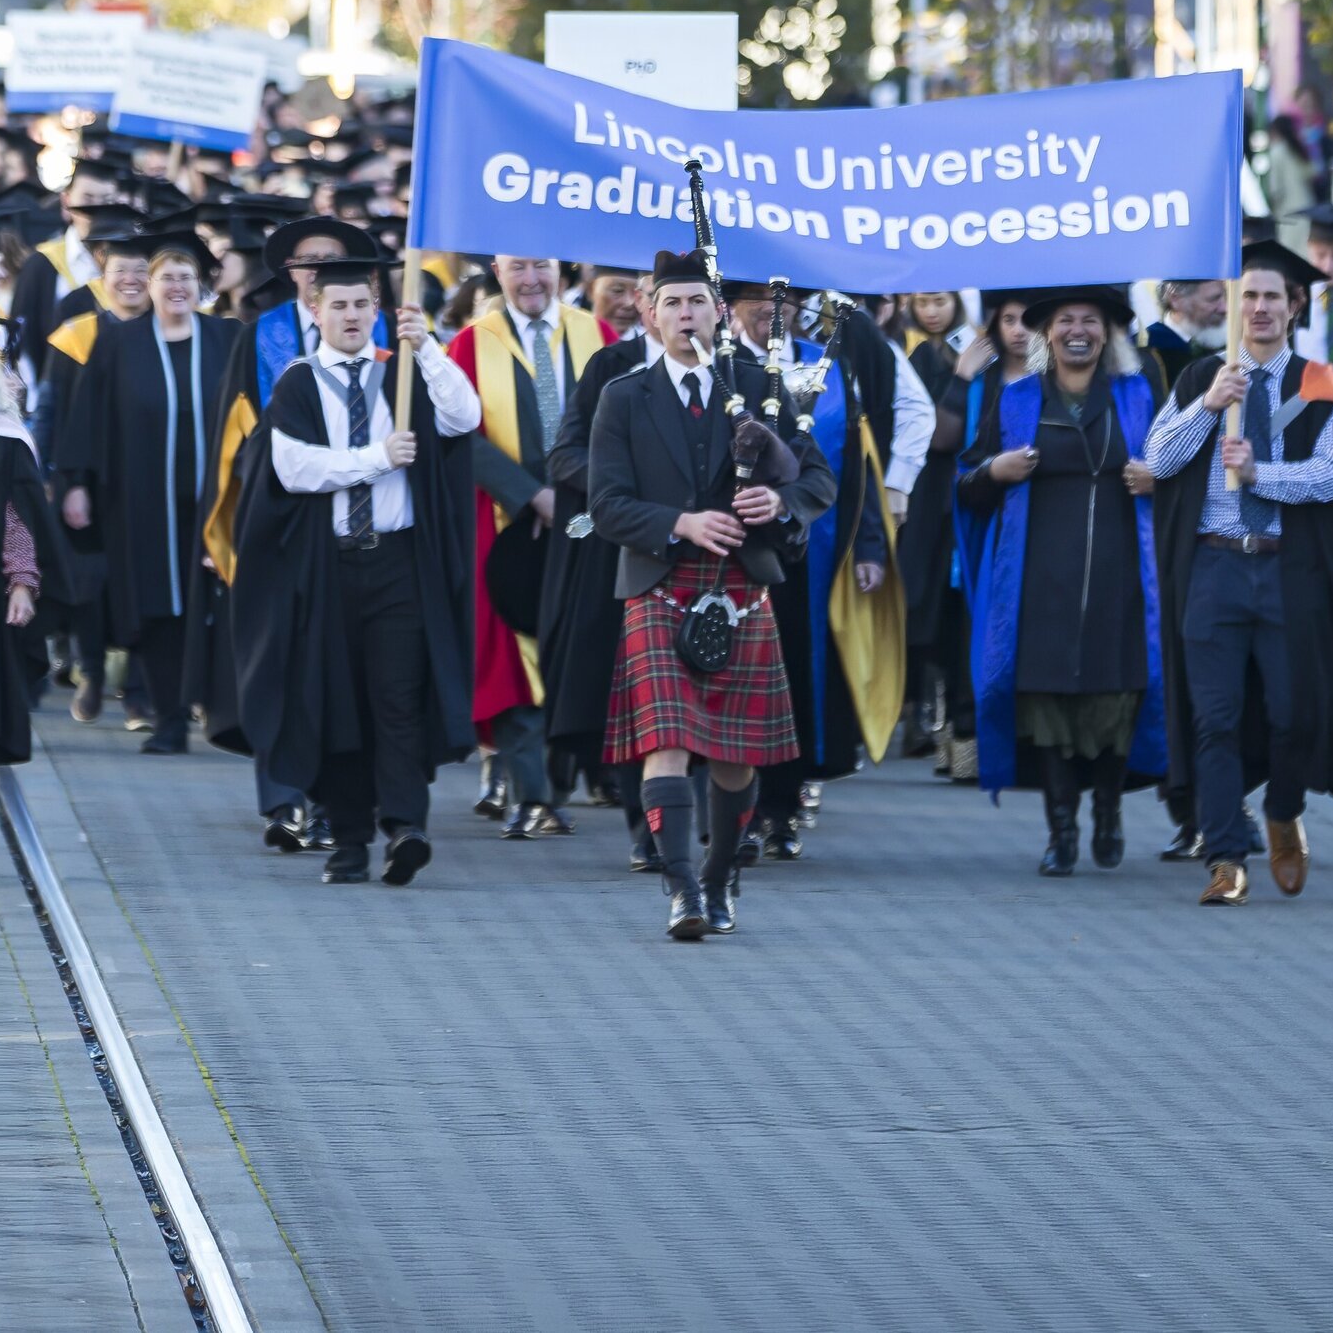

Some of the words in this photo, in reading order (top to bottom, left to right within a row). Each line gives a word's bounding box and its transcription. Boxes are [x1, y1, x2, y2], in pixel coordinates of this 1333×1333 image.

[574, 101, 778, 185] Lincoln
[795, 130, 1101, 191] University
[482, 152, 831, 240] Graduation
[842, 185, 1190, 250] Procession
